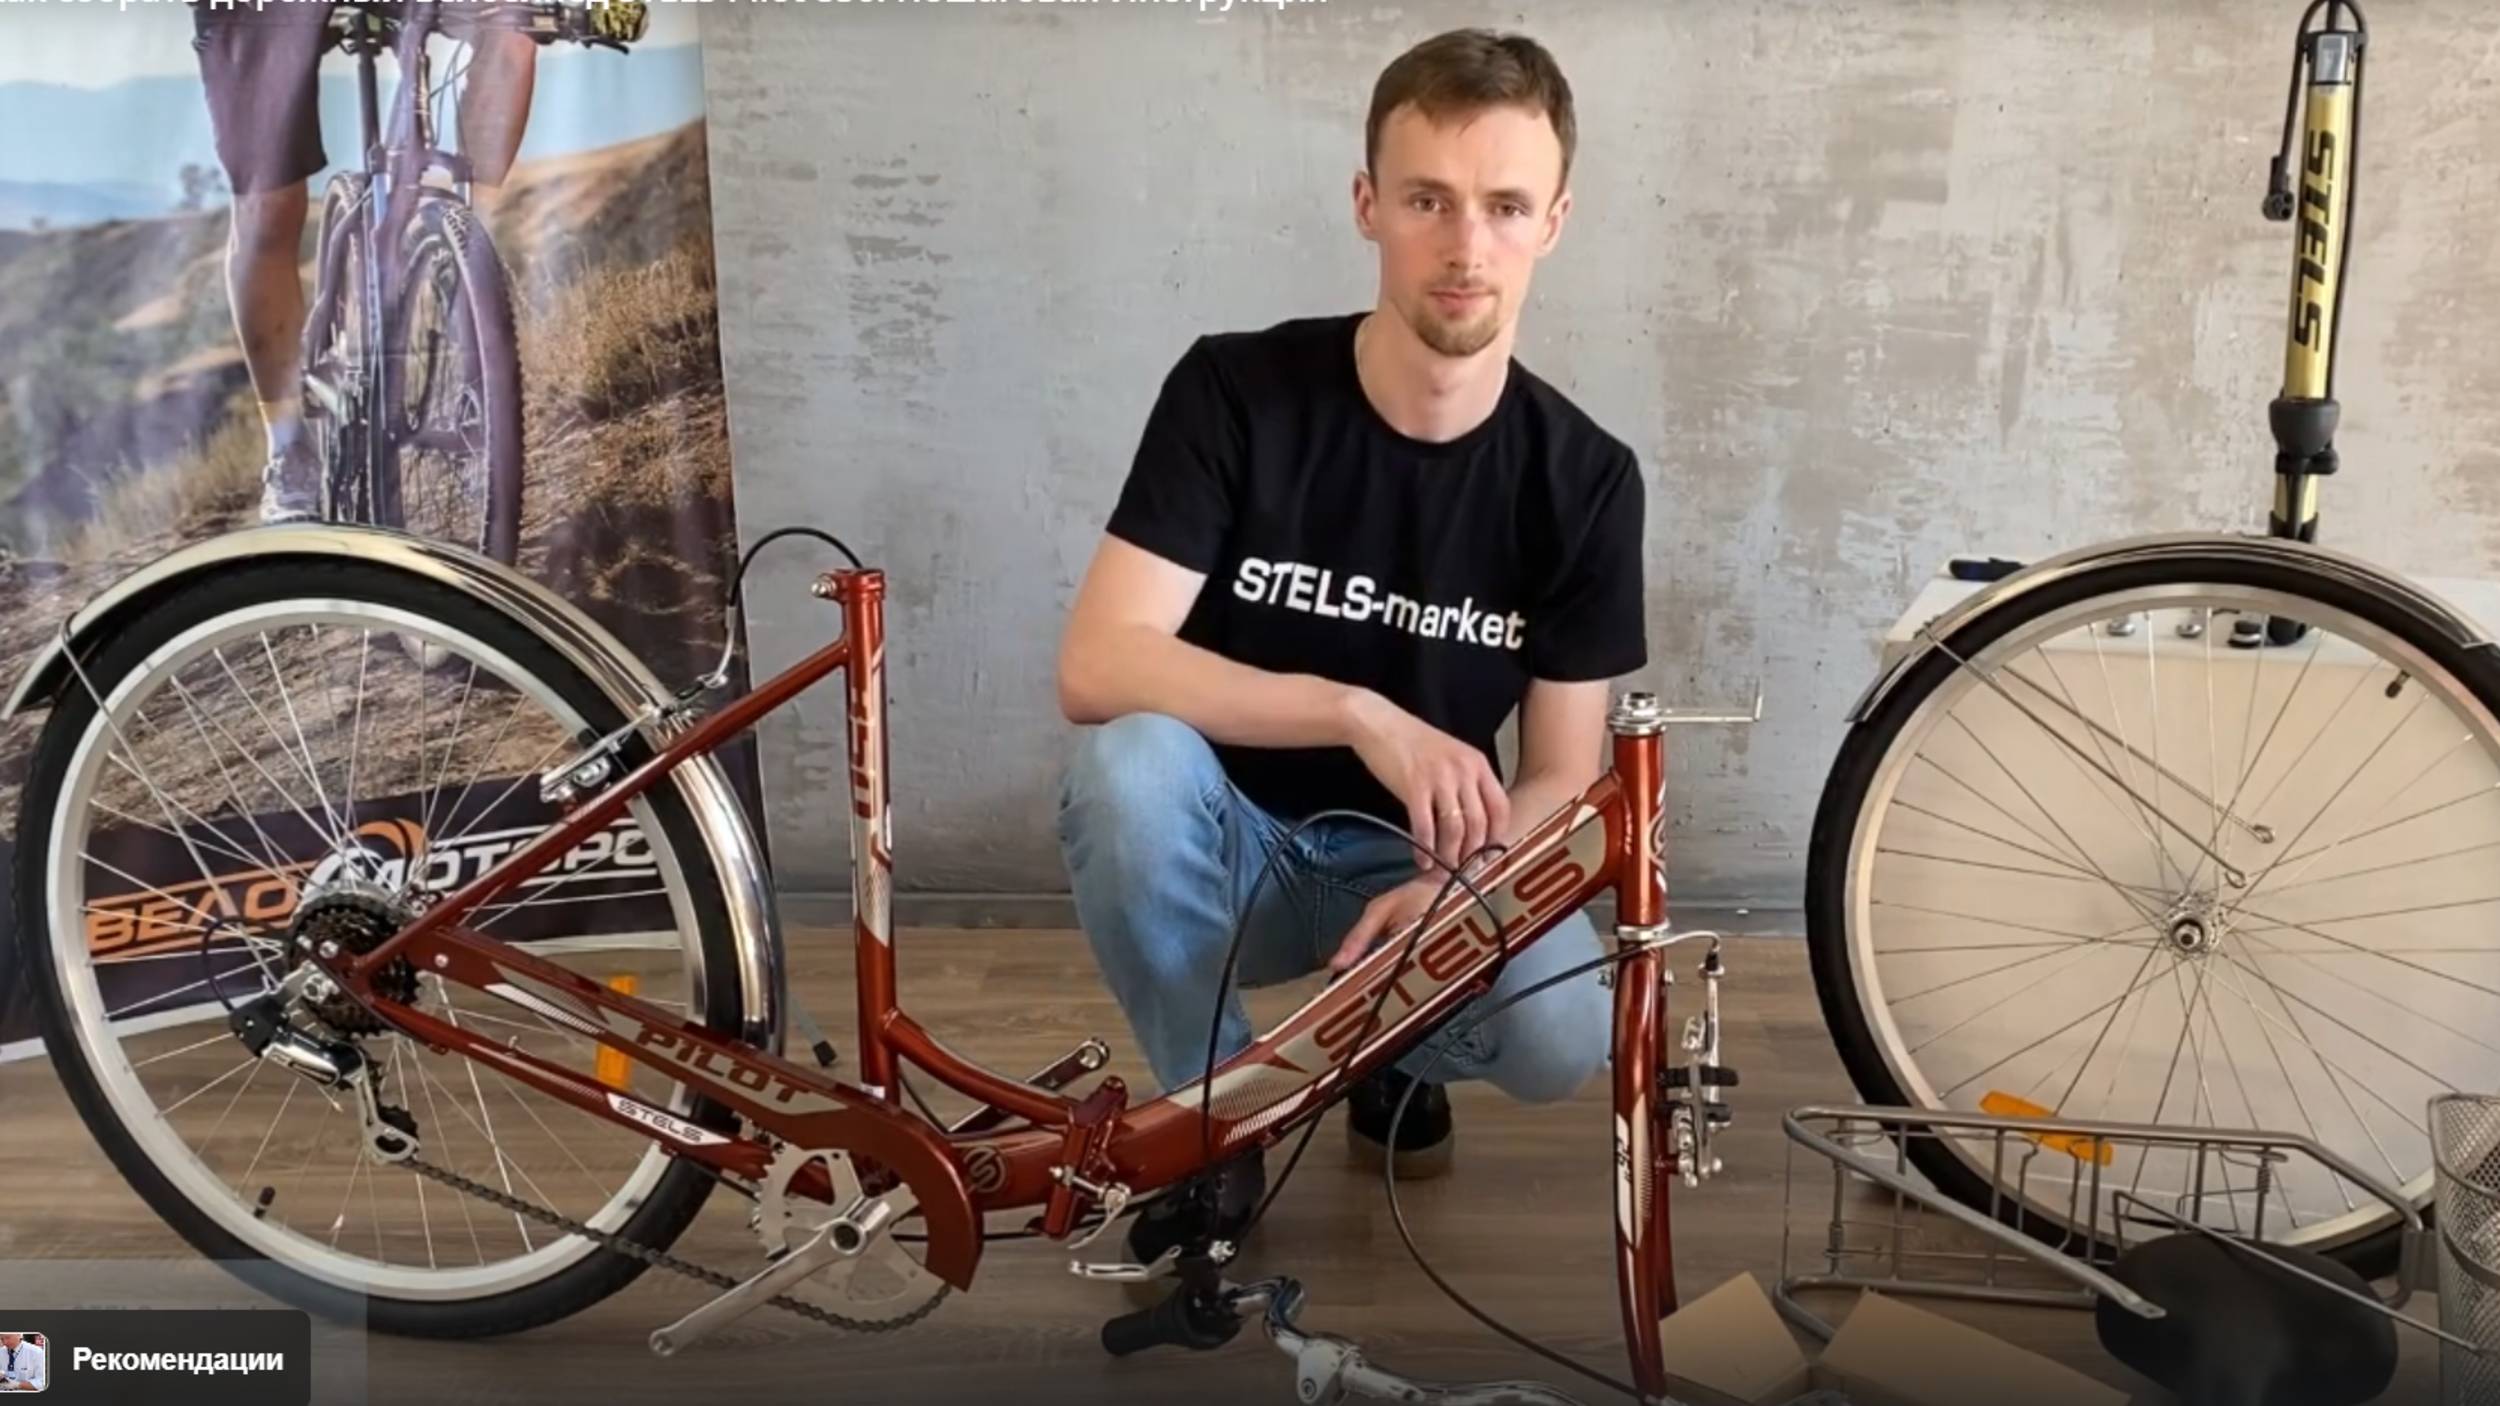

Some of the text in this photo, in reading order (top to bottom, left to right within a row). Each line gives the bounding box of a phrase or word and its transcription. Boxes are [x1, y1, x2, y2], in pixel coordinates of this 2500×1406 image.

[2294, 129, 2336, 352] STELS
[1232, 556, 1527, 650] STELS-market
[1313, 845, 1586, 1063] STELS
[635, 1024, 809, 1104] PILOT
[616, 1099, 704, 1143] STELS
